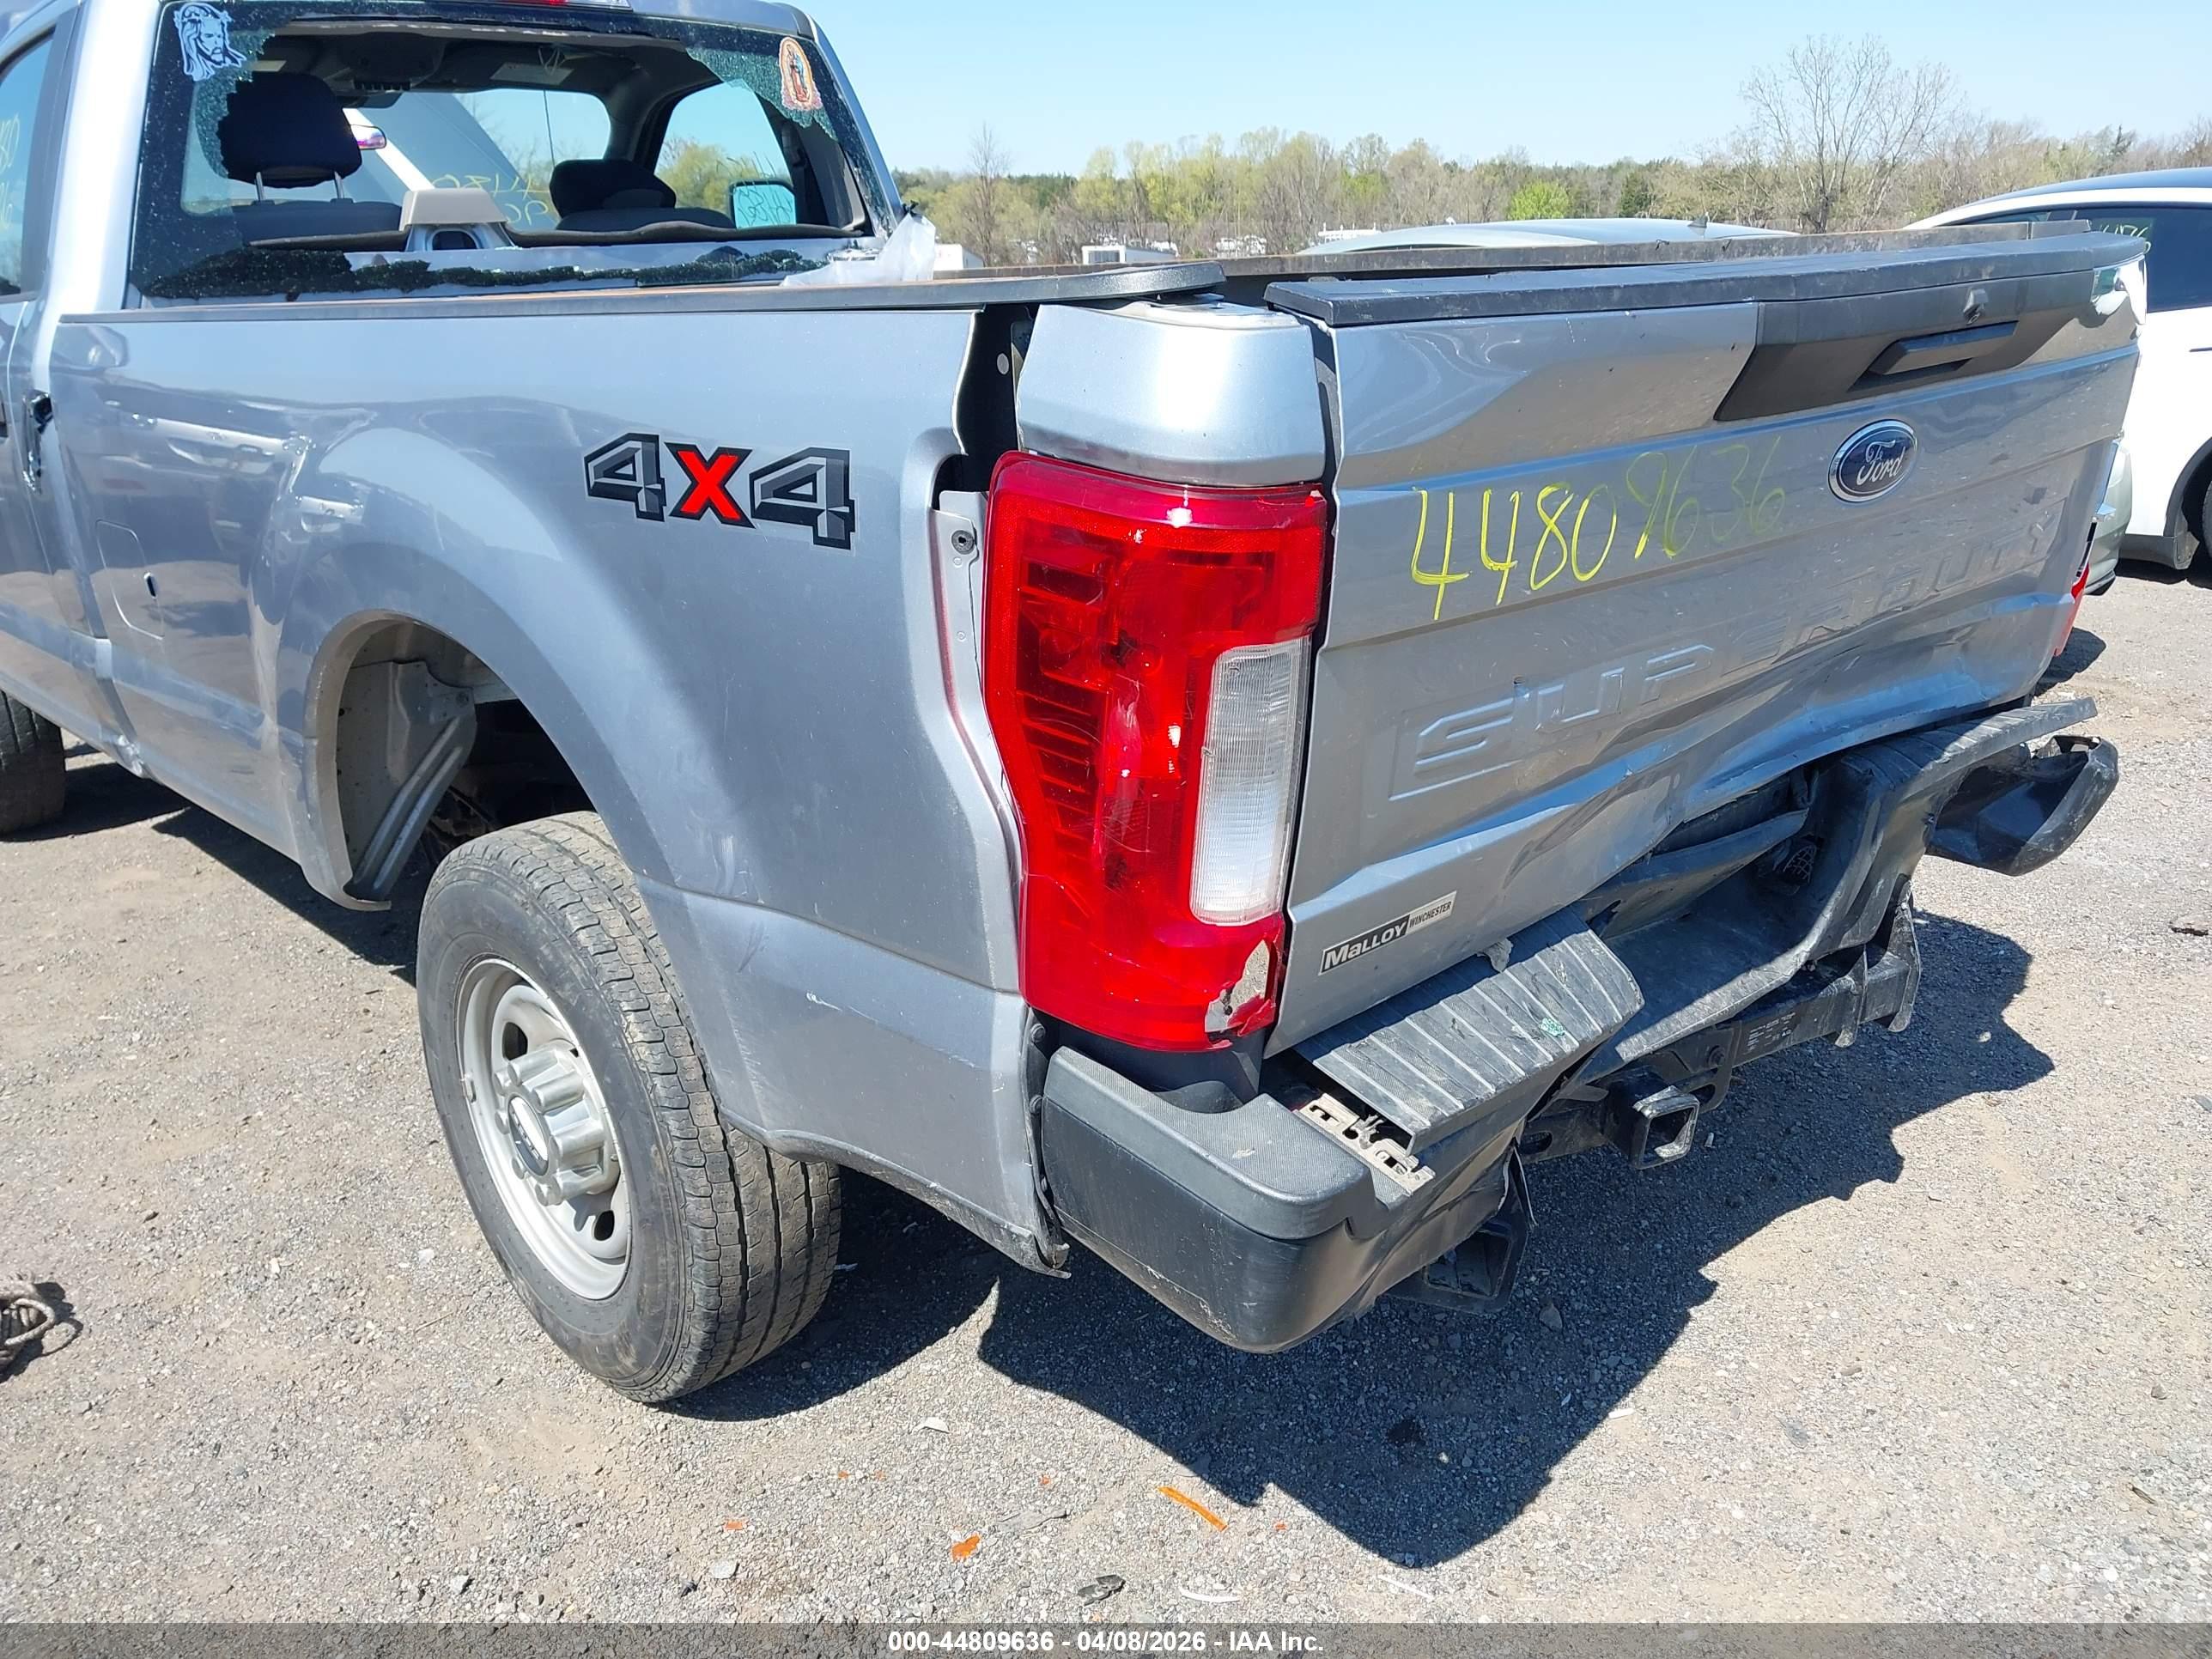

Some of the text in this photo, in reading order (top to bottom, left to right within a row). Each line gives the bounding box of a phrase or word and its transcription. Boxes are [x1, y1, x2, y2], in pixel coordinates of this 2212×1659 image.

[1856, 440, 1906, 486] Ford
[1411, 435, 1786, 621] 44809636
[1409, 901, 1451, 928] WINCHESTER
